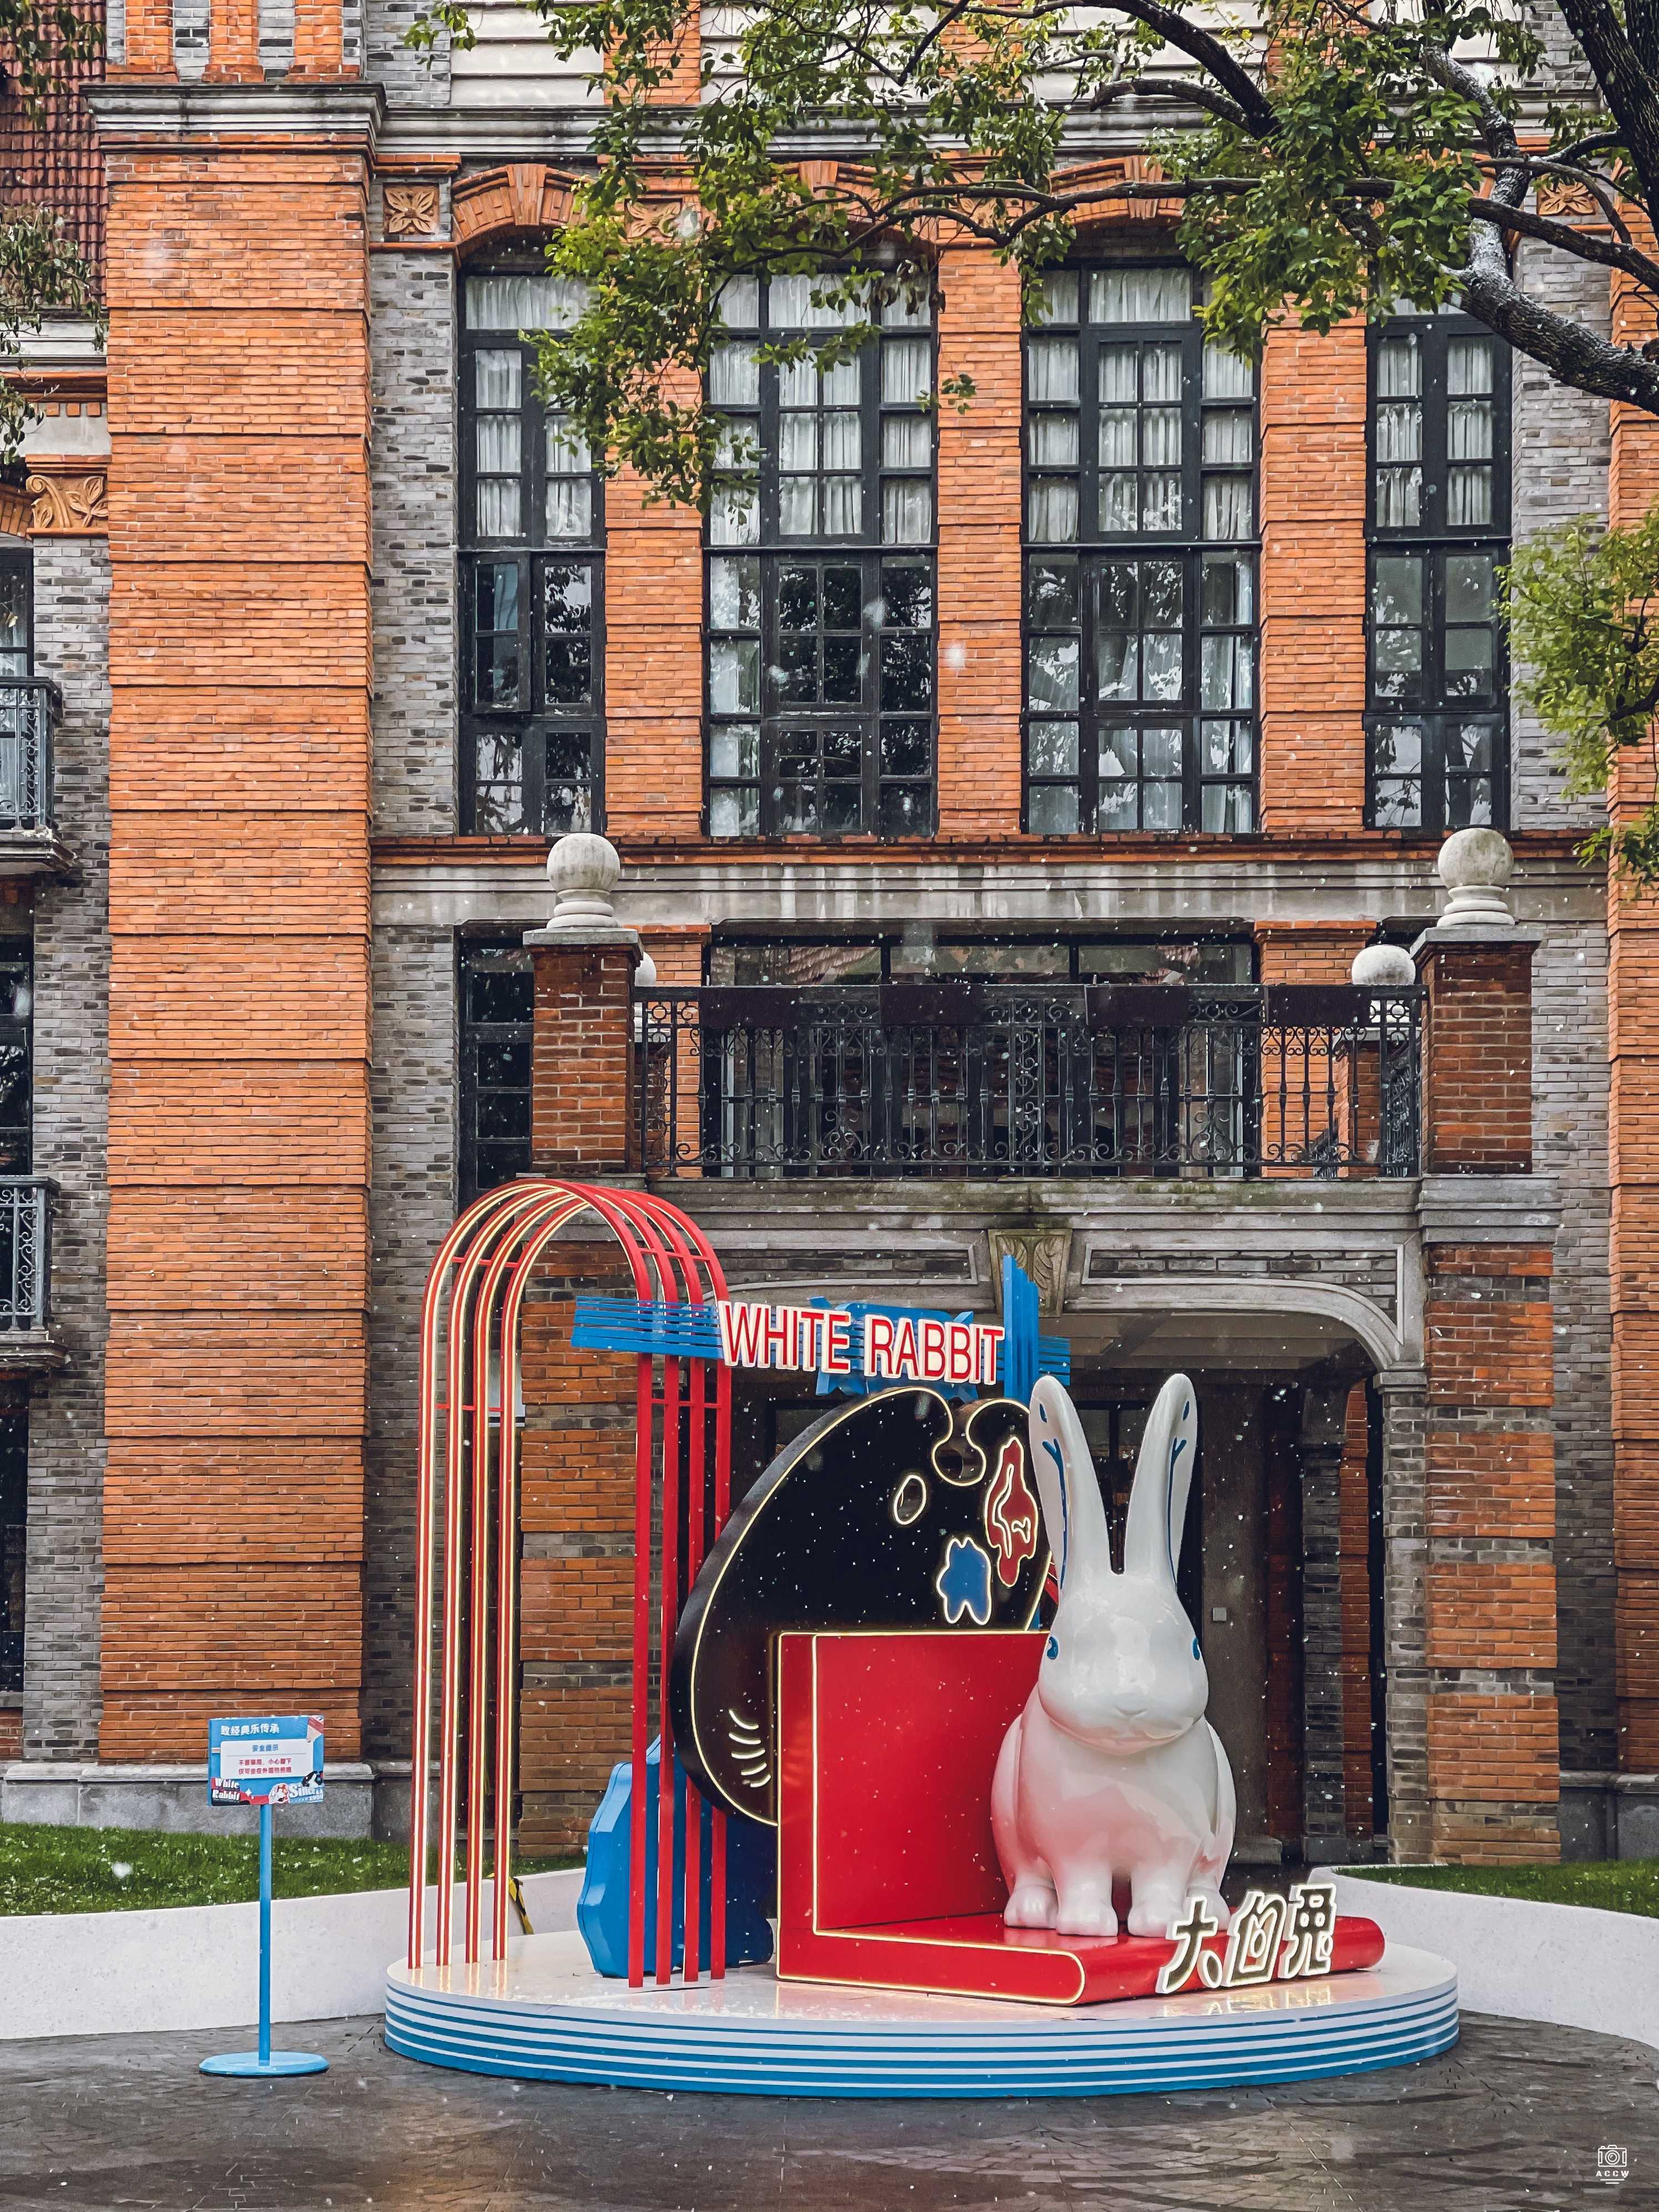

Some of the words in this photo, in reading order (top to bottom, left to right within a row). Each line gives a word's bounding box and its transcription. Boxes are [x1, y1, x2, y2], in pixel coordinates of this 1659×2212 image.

[718, 1300, 851, 1374] WHITE
[864, 1314, 1005, 1384] RABBIT
[1155, 1884, 1337, 1994] 大白兔
